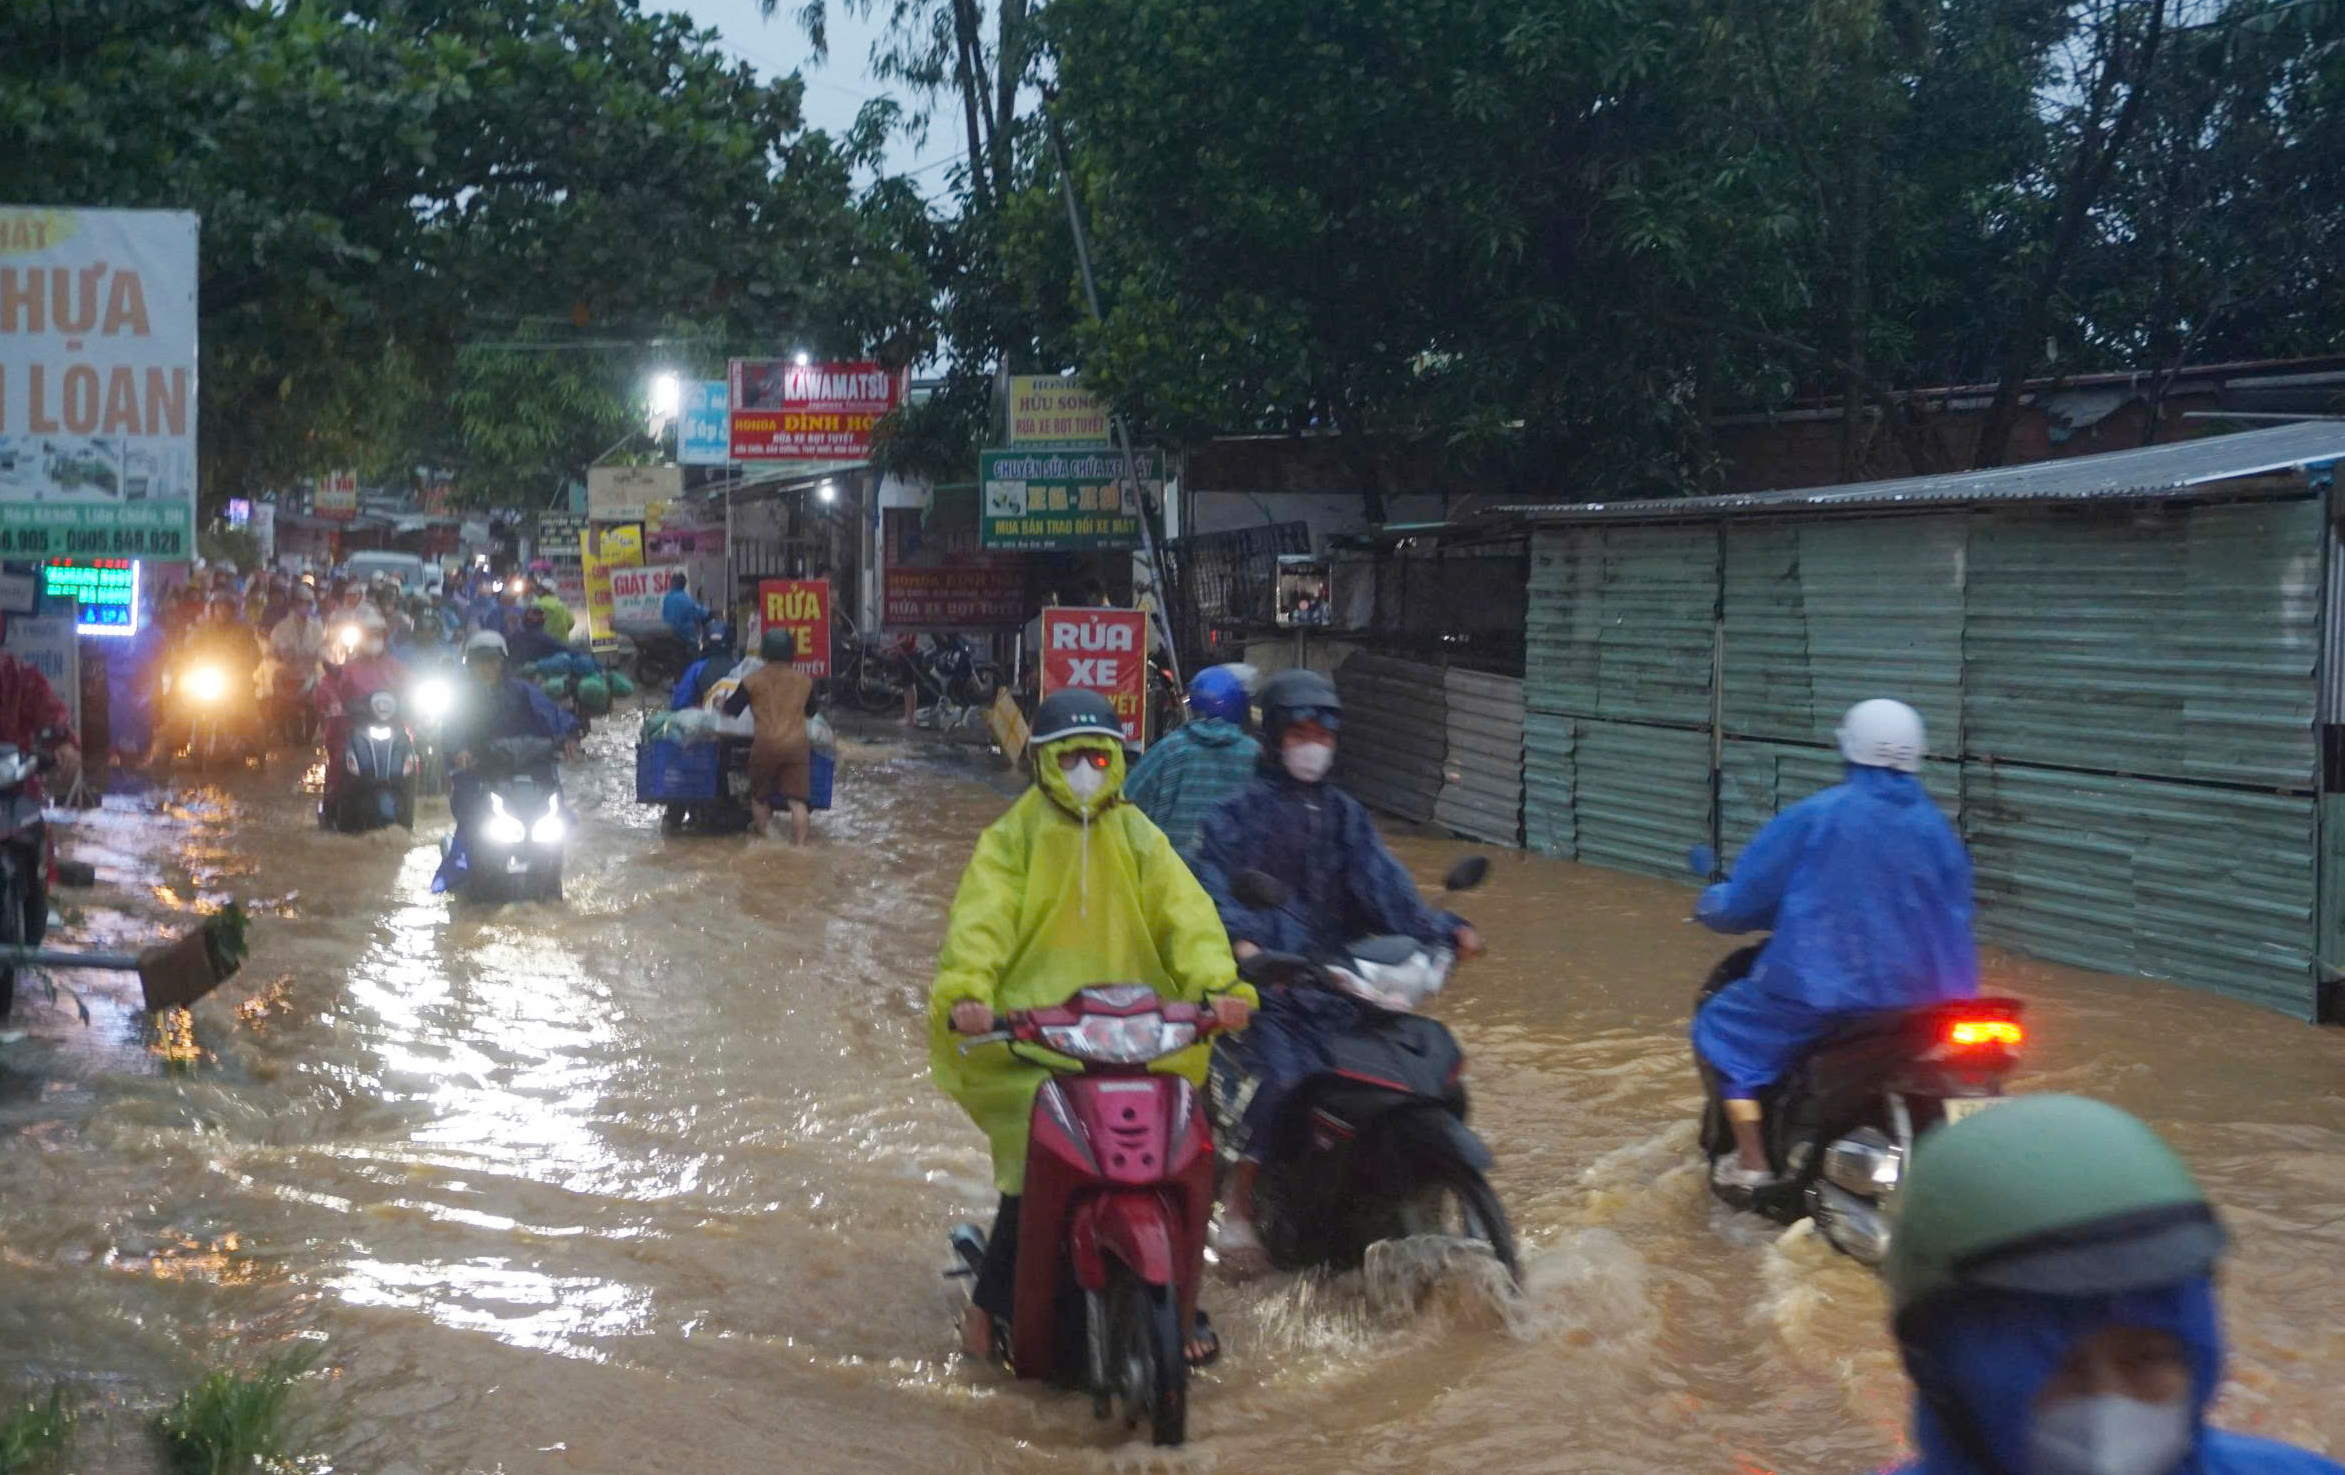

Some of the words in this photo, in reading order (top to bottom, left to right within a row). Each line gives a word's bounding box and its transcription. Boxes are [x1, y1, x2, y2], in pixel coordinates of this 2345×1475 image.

[29, 362, 186, 436] LOAN
[784, 371, 889, 401] KAWAMATSU
[992, 454, 1042, 479] CHUYÊN
[1105, 459, 1123, 479] XE
[995, 518, 1018, 535] MUA
[1095, 518, 1108, 535] XE
[767, 582, 821, 622] RỬA
[1053, 615, 1132, 651] RỬA
[1067, 658, 1118, 687] XE
